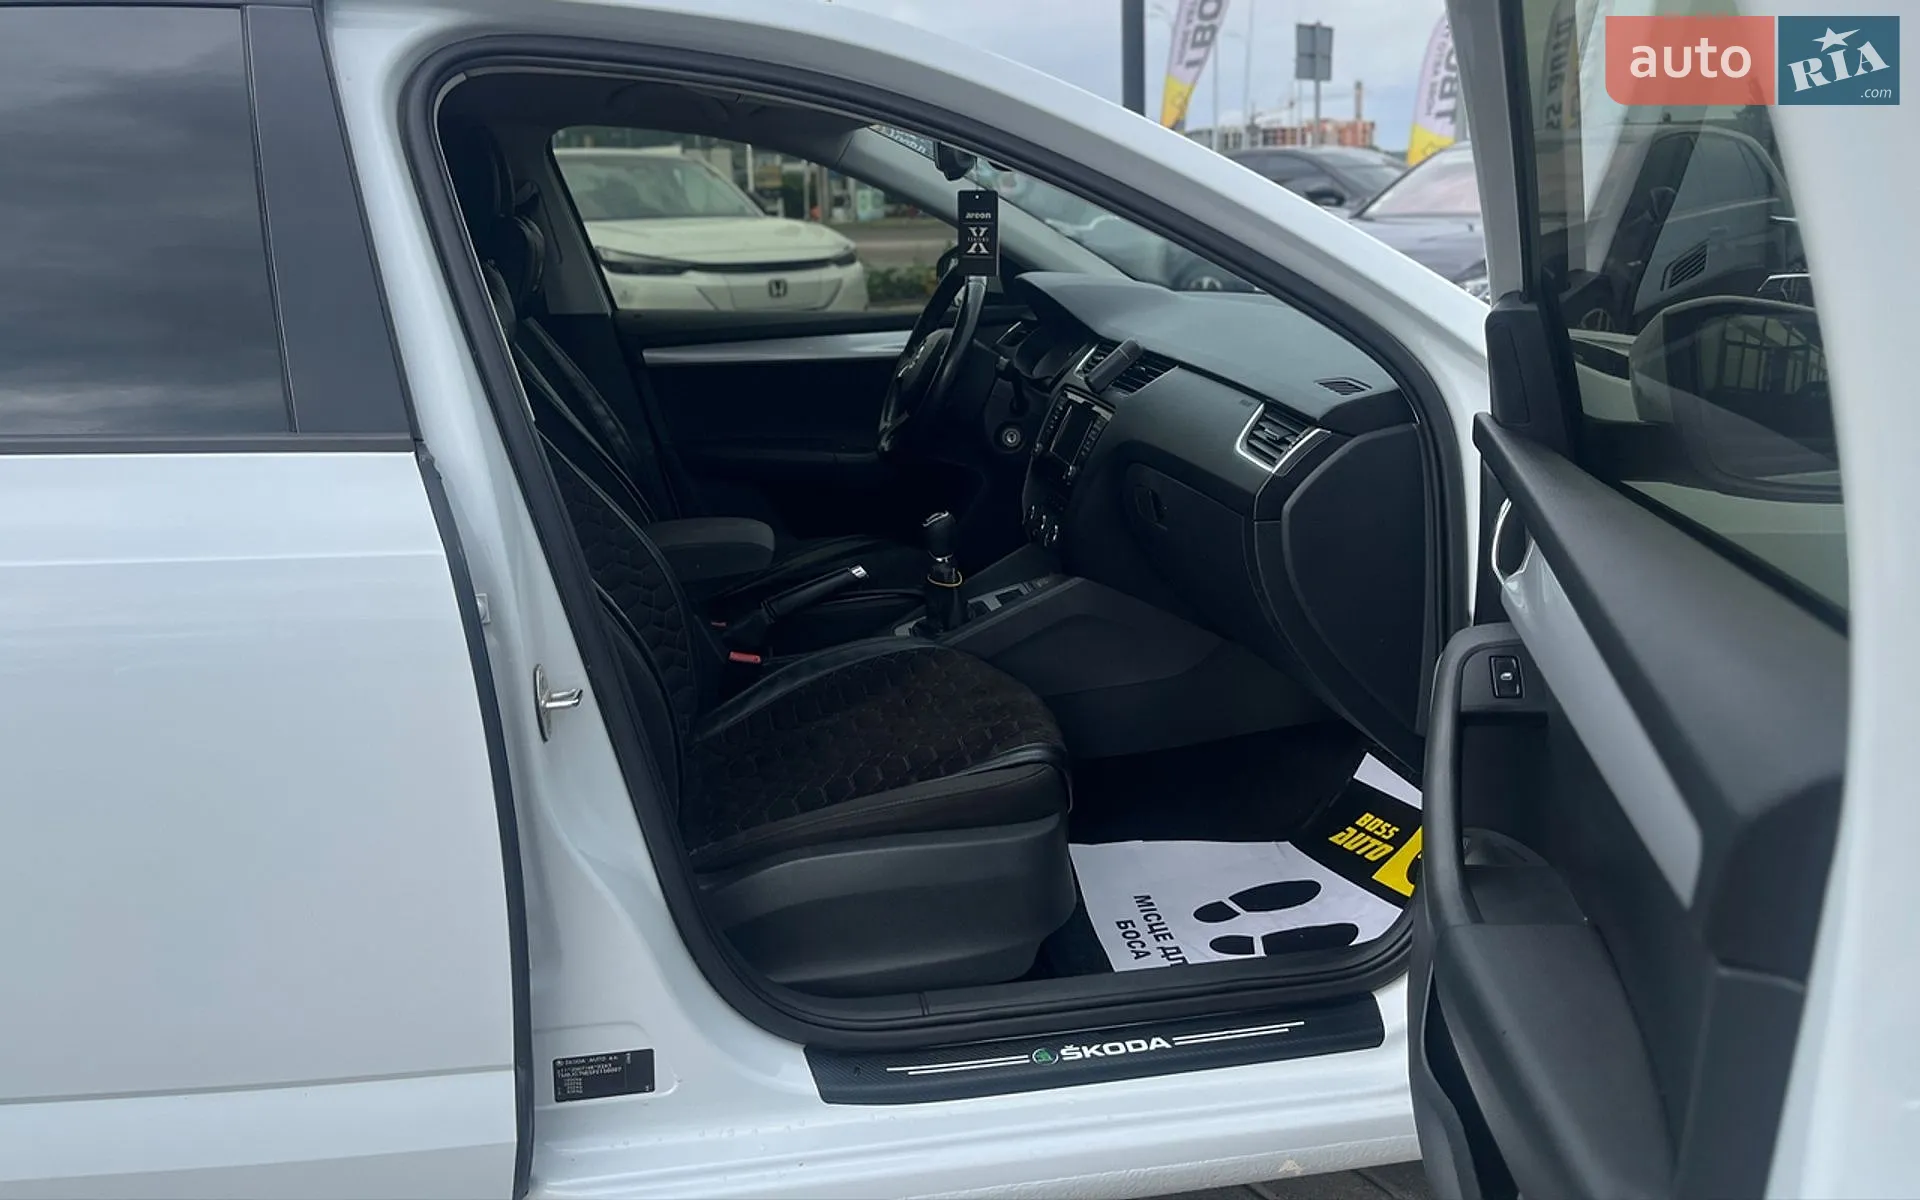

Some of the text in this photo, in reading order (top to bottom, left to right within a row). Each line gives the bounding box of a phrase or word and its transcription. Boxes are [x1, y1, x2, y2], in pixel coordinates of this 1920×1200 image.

[1328, 826, 1394, 861] AUTO
[1355, 812, 1400, 840] BOSS
[1133, 895, 1174, 942] МІСЦЕ
[1115, 919, 1152, 960] БОСА
[1060, 1036, 1172, 1061] ŠKODA
